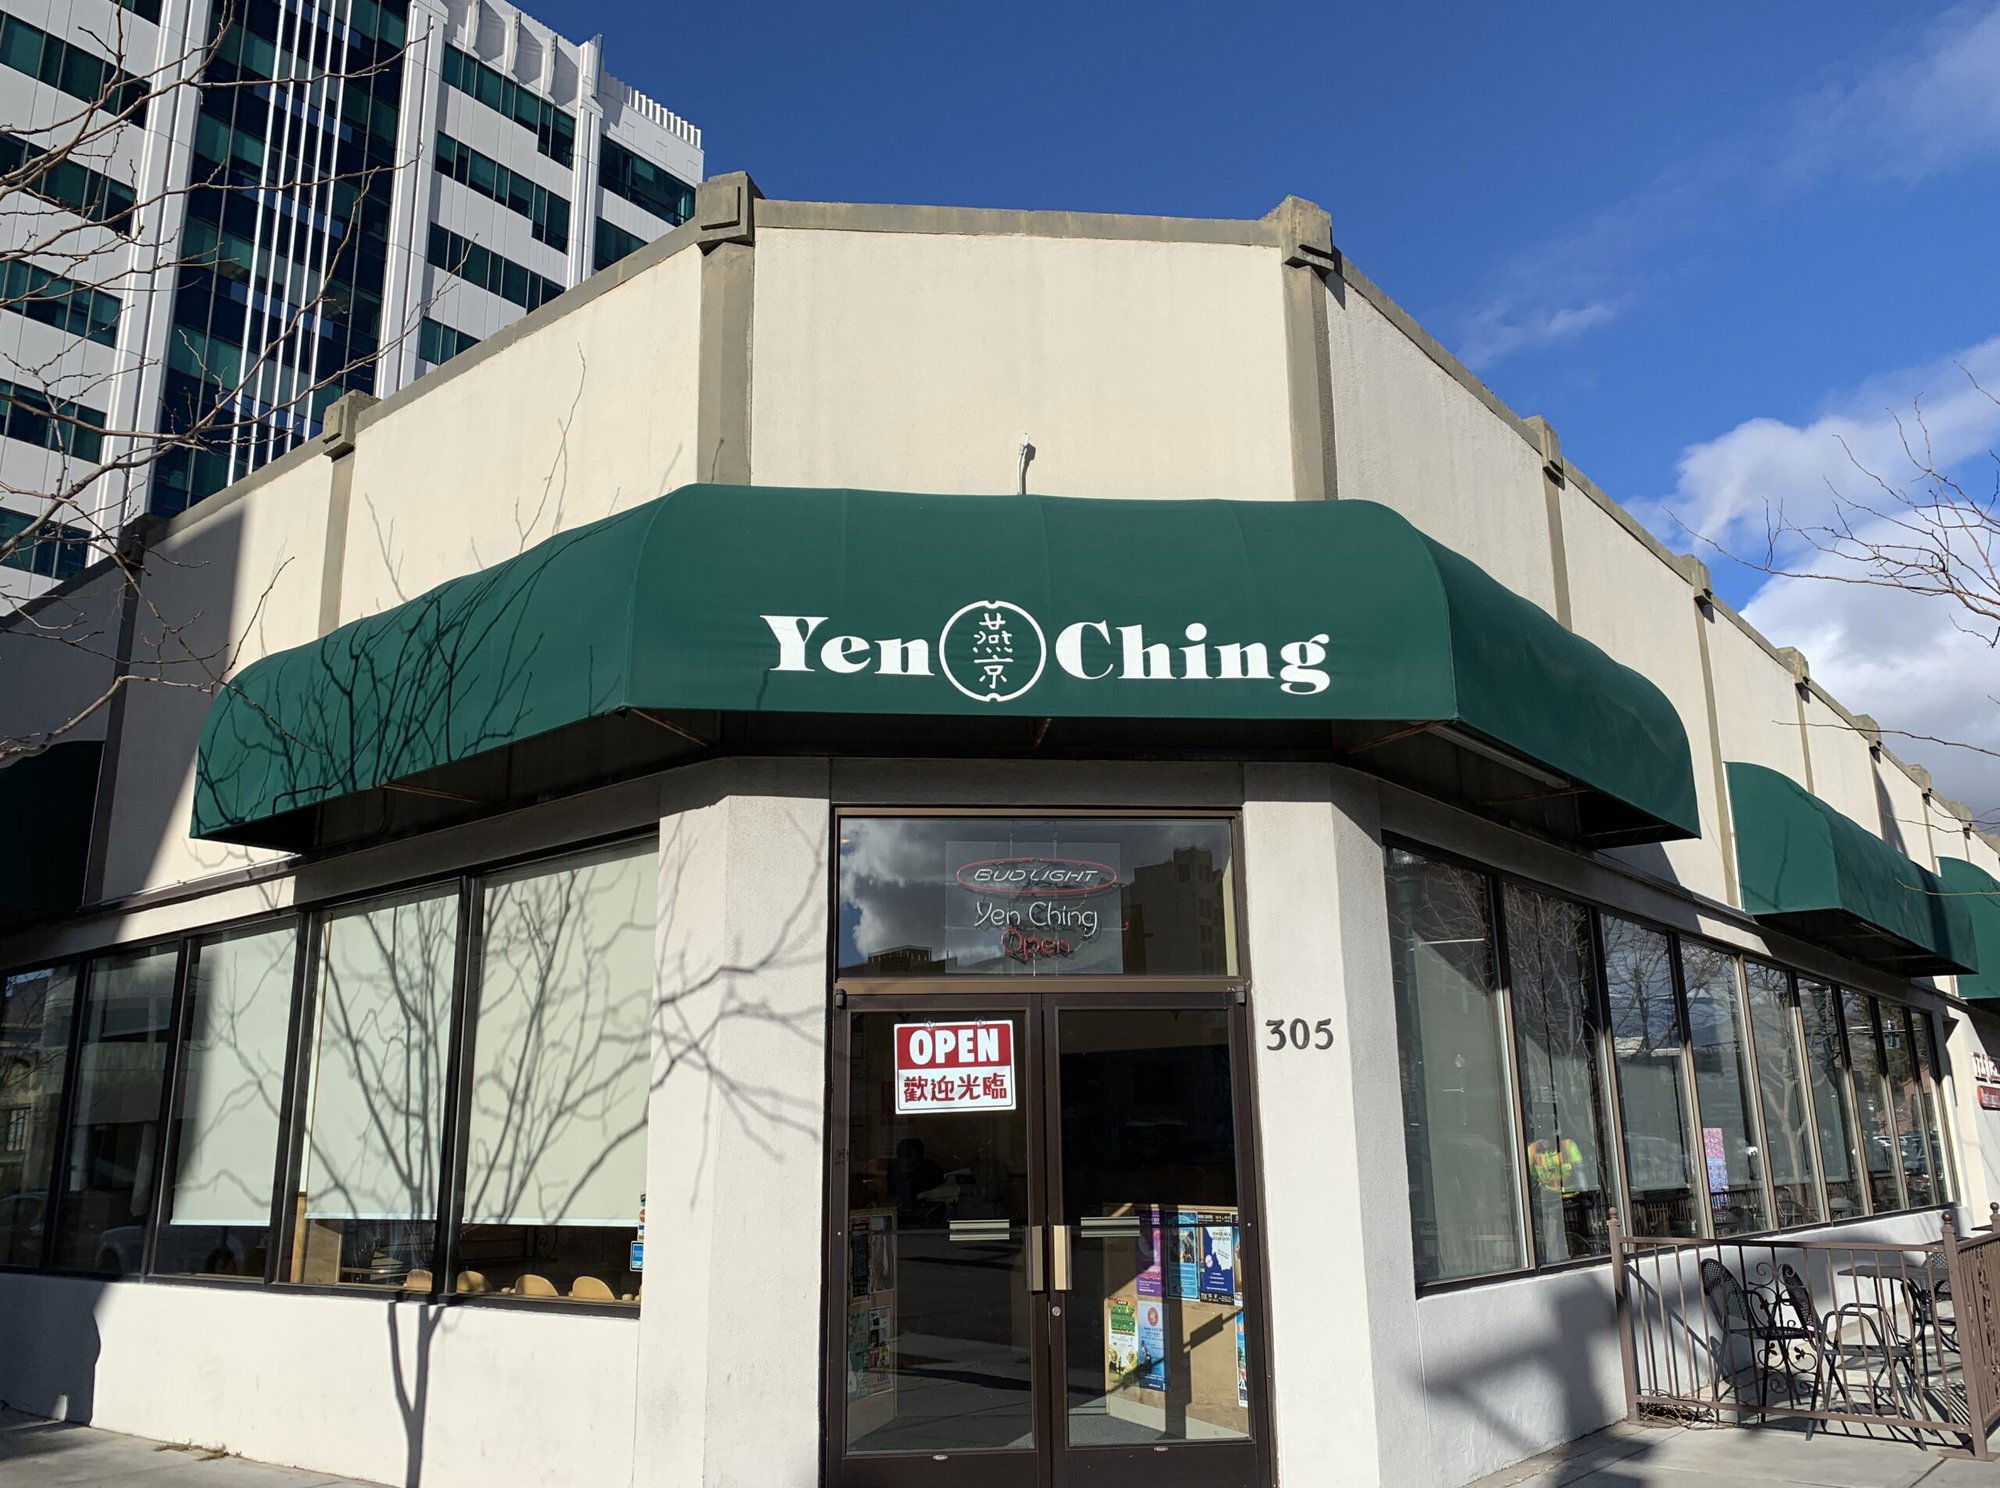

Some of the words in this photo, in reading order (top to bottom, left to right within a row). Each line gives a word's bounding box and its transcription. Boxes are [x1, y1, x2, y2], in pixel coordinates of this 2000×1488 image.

[759, 615, 936, 676] Yen
[1055, 621, 1331, 695] Ching
[973, 612, 1014, 690] 燕京
[974, 868, 1027, 882] BUD
[1029, 869, 1099, 882] LIGHT
[974, 901, 1021, 926] Yen
[1028, 901, 1098, 937] Ching
[1001, 928, 1073, 960] Open
[909, 1028, 1000, 1065] OPEN
[1265, 1017, 1334, 1051] 305
[903, 1072, 1007, 1103] 歡迎光臨
